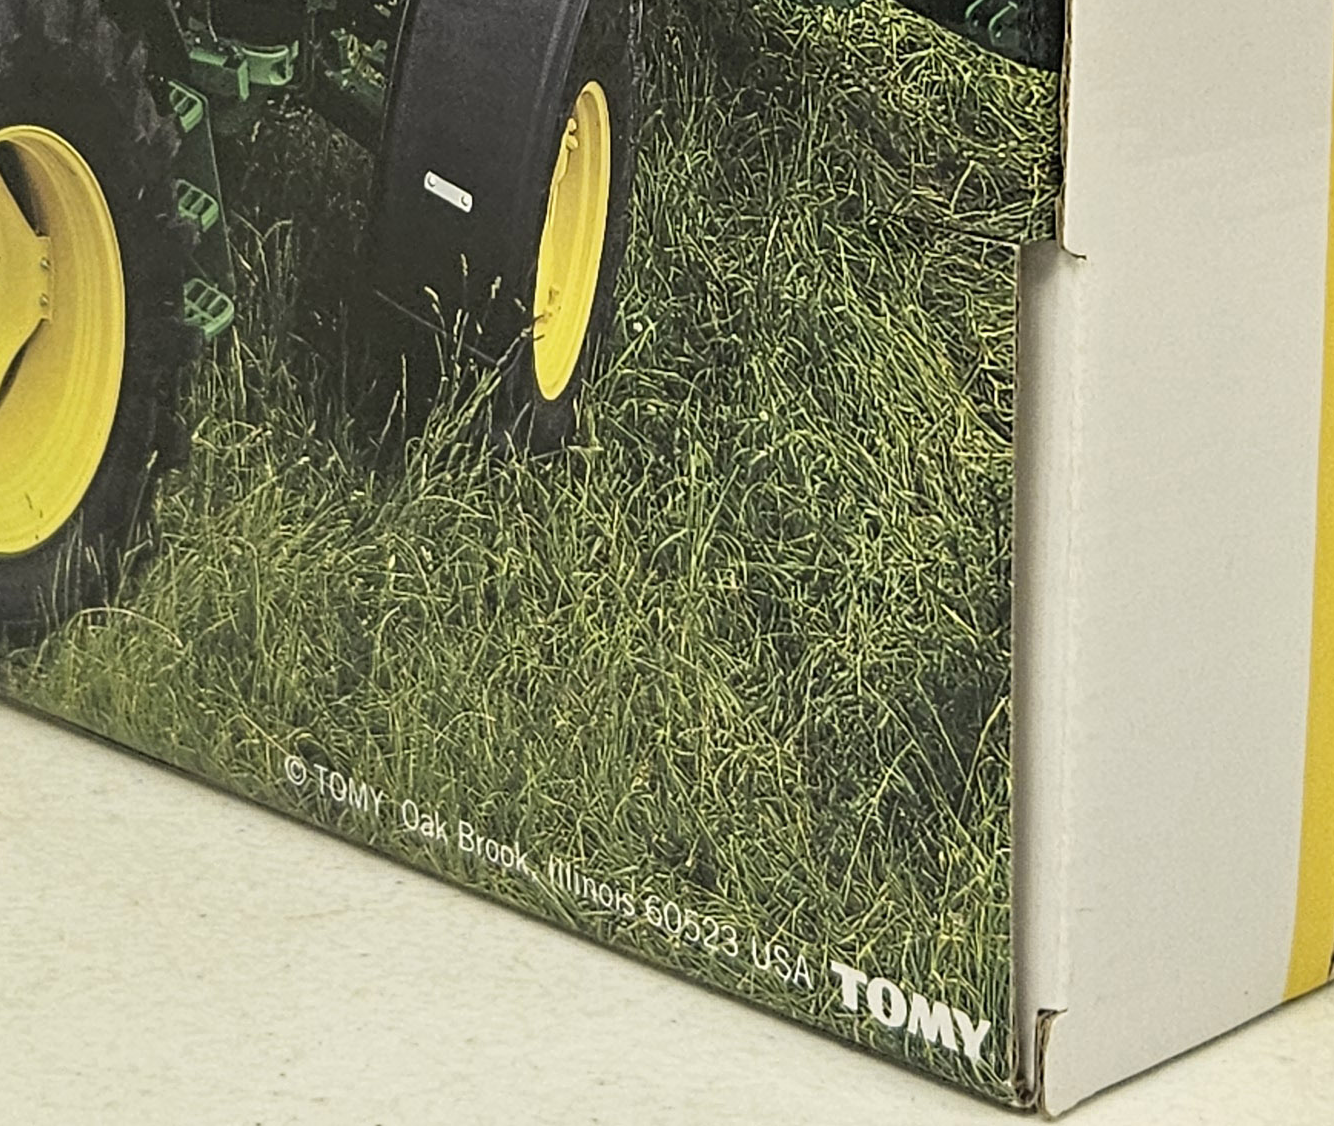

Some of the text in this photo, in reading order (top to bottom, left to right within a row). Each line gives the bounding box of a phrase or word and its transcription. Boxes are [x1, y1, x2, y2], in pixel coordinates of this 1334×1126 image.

[313, 763, 384, 817] TOMY
[402, 799, 448, 844] Oak
[548, 853, 635, 916] Illinois
[645, 894, 739, 957] 60523
[751, 936, 814, 990] USA
[831, 960, 991, 1064] TOMY
